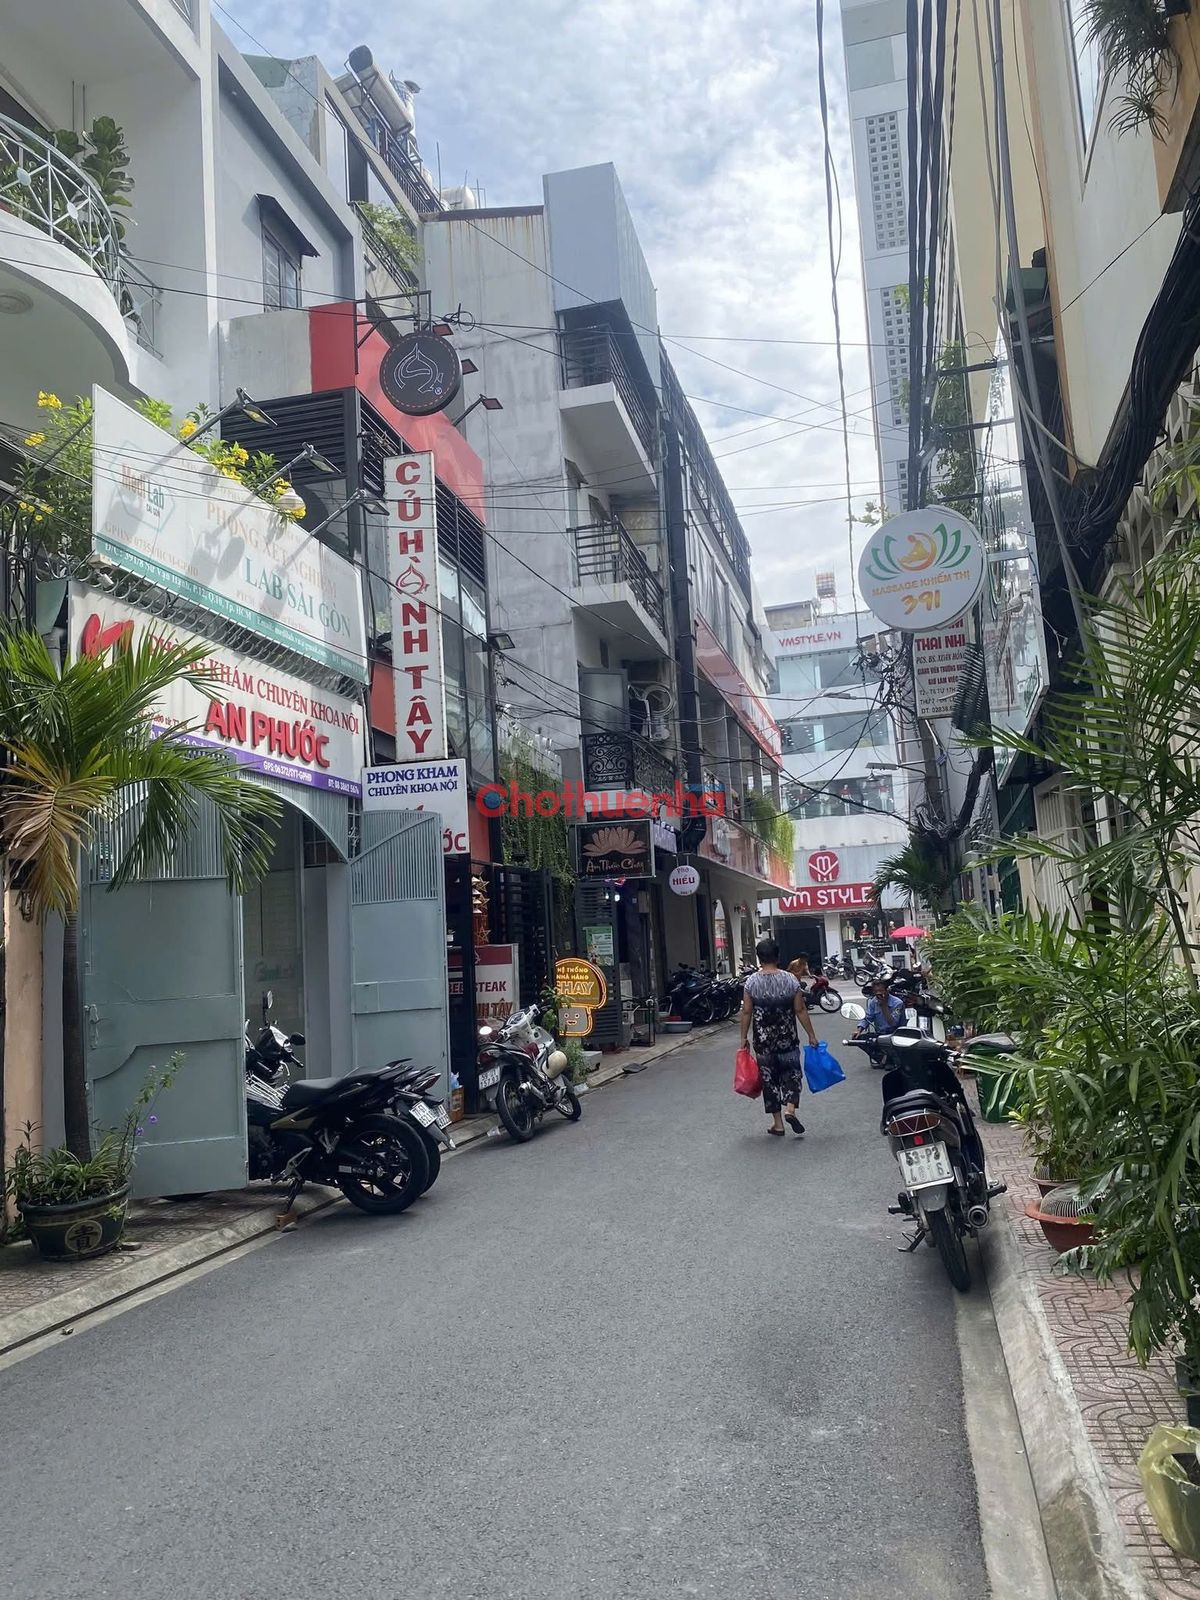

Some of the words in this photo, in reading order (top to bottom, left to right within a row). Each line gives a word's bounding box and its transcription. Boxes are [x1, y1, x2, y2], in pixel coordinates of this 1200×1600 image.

[245, 556, 284, 601] LAB
[287, 581, 314, 620] SÀI
[319, 601, 351, 638] GÒN
[901, 589, 942, 615] 391
[944, 633, 966, 649] NHI
[257, 678, 308, 716] CHUYÊN
[310, 699, 341, 728] KHOA
[341, 712, 360, 735] NỘI
[404, 665, 433, 754] TÂY
[204, 698, 247, 744] AN
[250, 710, 330, 768] PHƯỚC
[368, 783, 409, 797] CHUYÊN
[410, 782, 438, 794] KHOA
[440, 779, 458, 792] NỘI
[816, 886, 873, 906] STYLE
